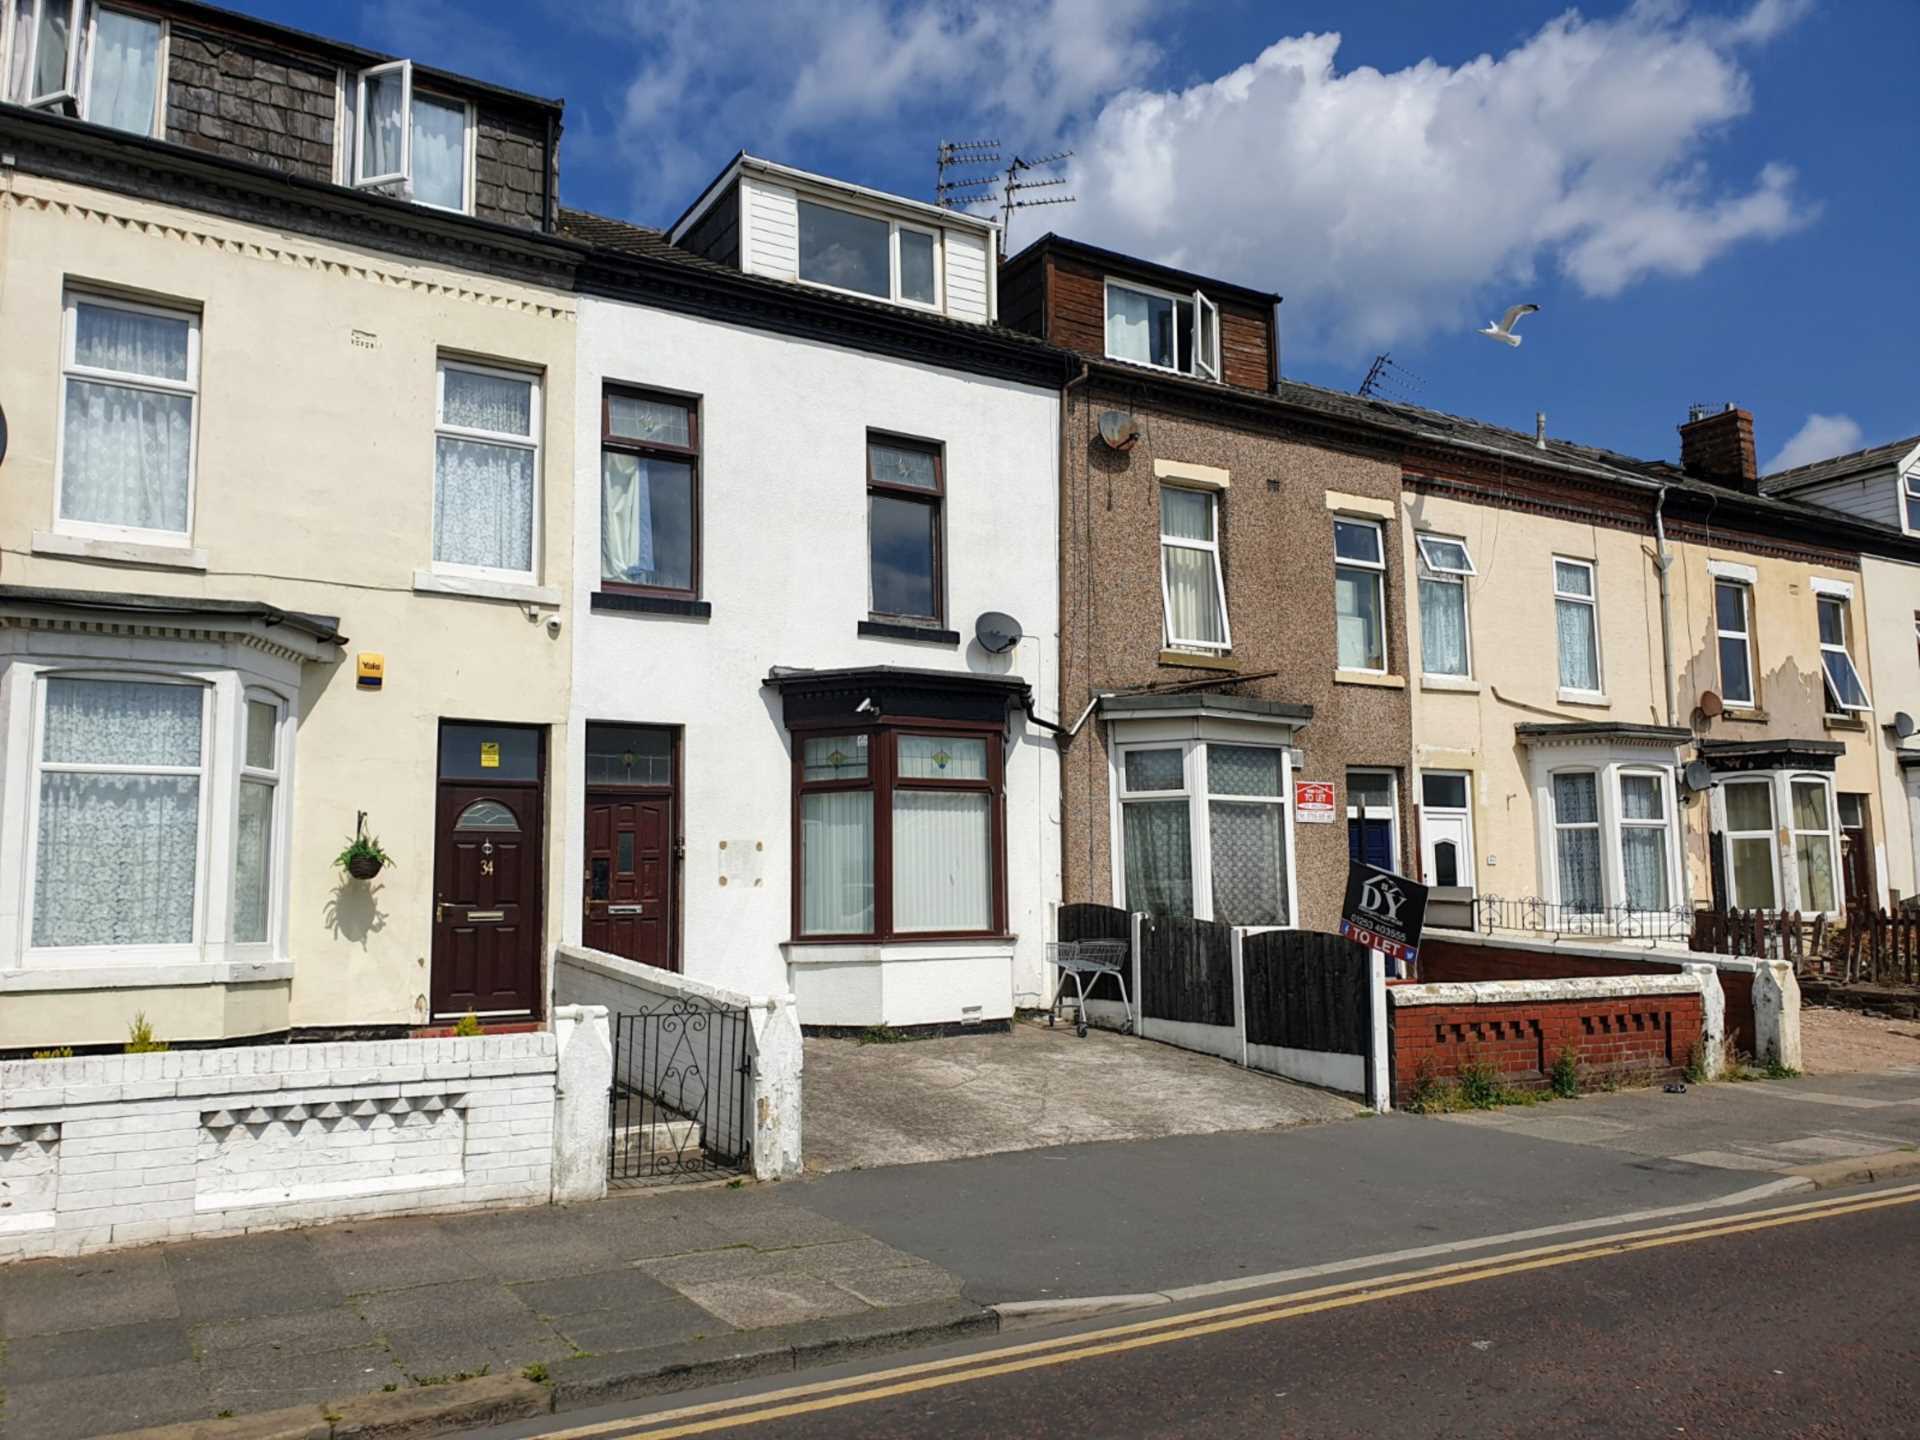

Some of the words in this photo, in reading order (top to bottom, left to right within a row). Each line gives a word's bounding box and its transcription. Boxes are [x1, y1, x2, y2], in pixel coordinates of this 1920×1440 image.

[362, 661, 381, 671] Yale
[480, 859, 494, 876] 34
[1358, 883, 1408, 920] DY
[1352, 926, 1370, 945] TO
[1374, 936, 1401, 956] LET
